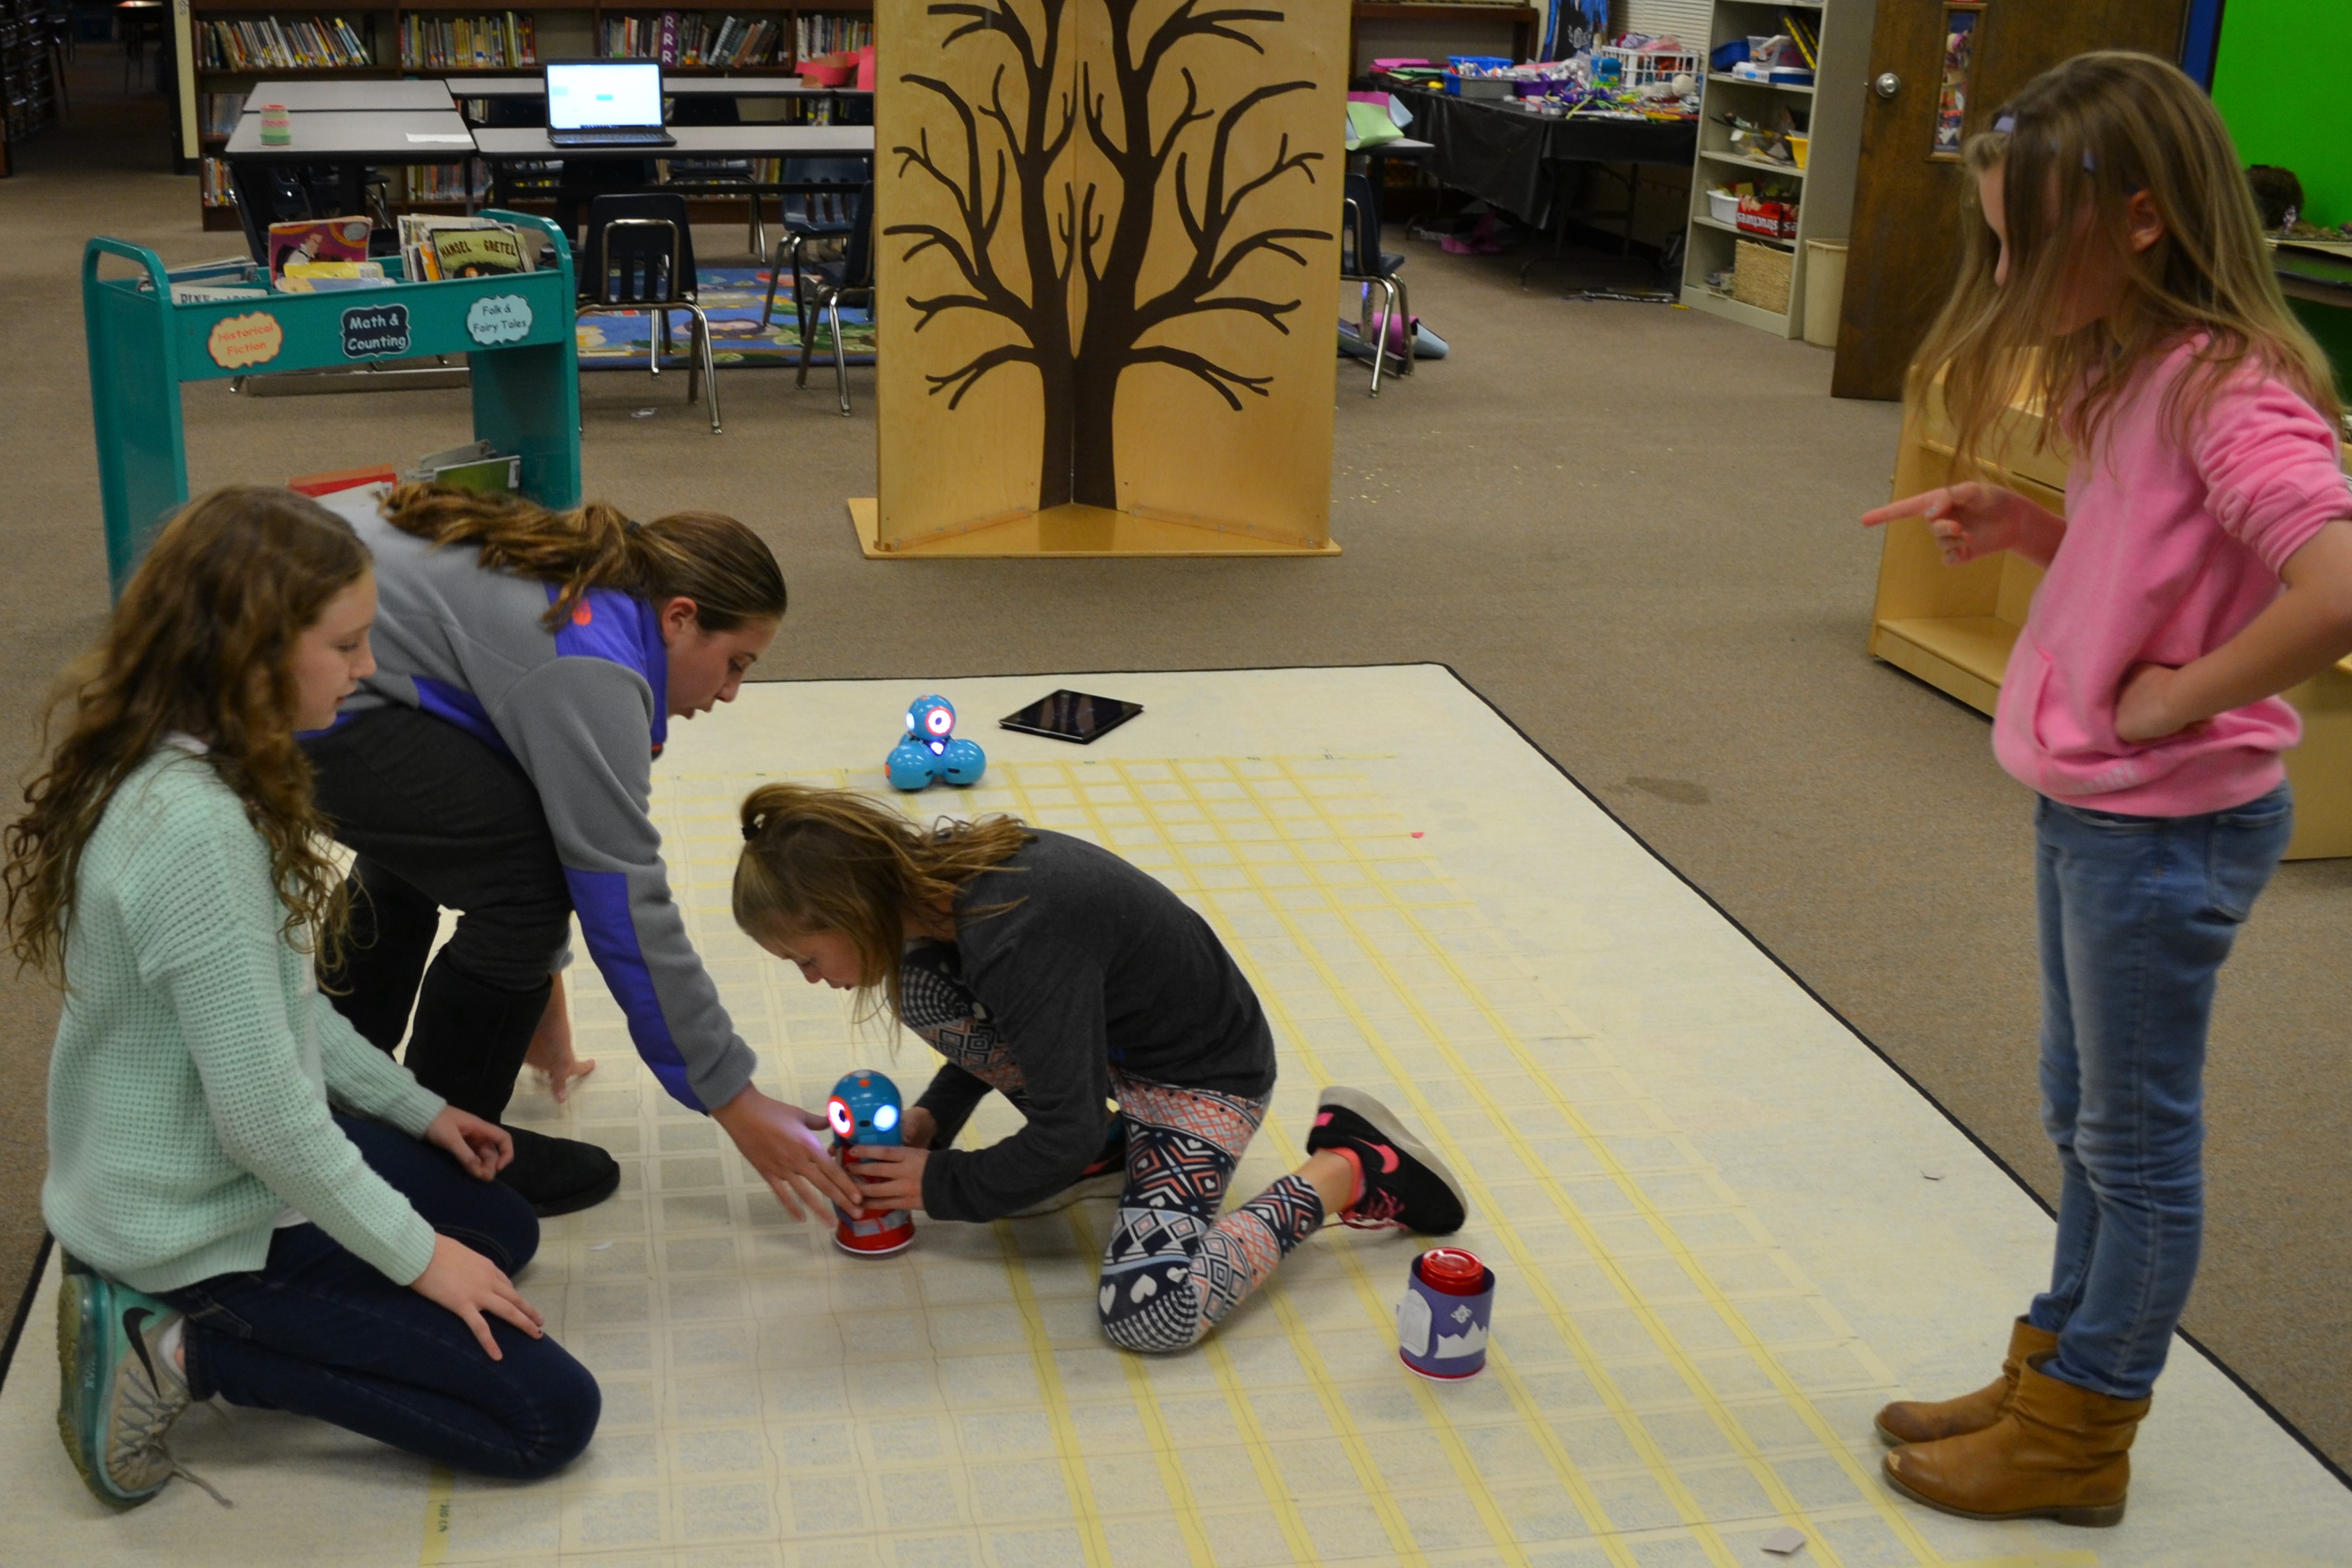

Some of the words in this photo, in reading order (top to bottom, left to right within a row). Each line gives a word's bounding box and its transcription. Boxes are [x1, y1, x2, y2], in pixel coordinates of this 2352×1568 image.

[439, 240, 472, 259] HANSEL
[484, 240, 516, 256] GRETEL
[482, 305, 503, 316] Folk
[350, 314, 386, 330] Math
[389, 313, 399, 326] &
[473, 322, 498, 334] Fairy
[500, 318, 527, 329] Tales
[218, 322, 273, 341] Historical
[227, 342, 267, 356] Fiction
[348, 334, 407, 350] Counting
